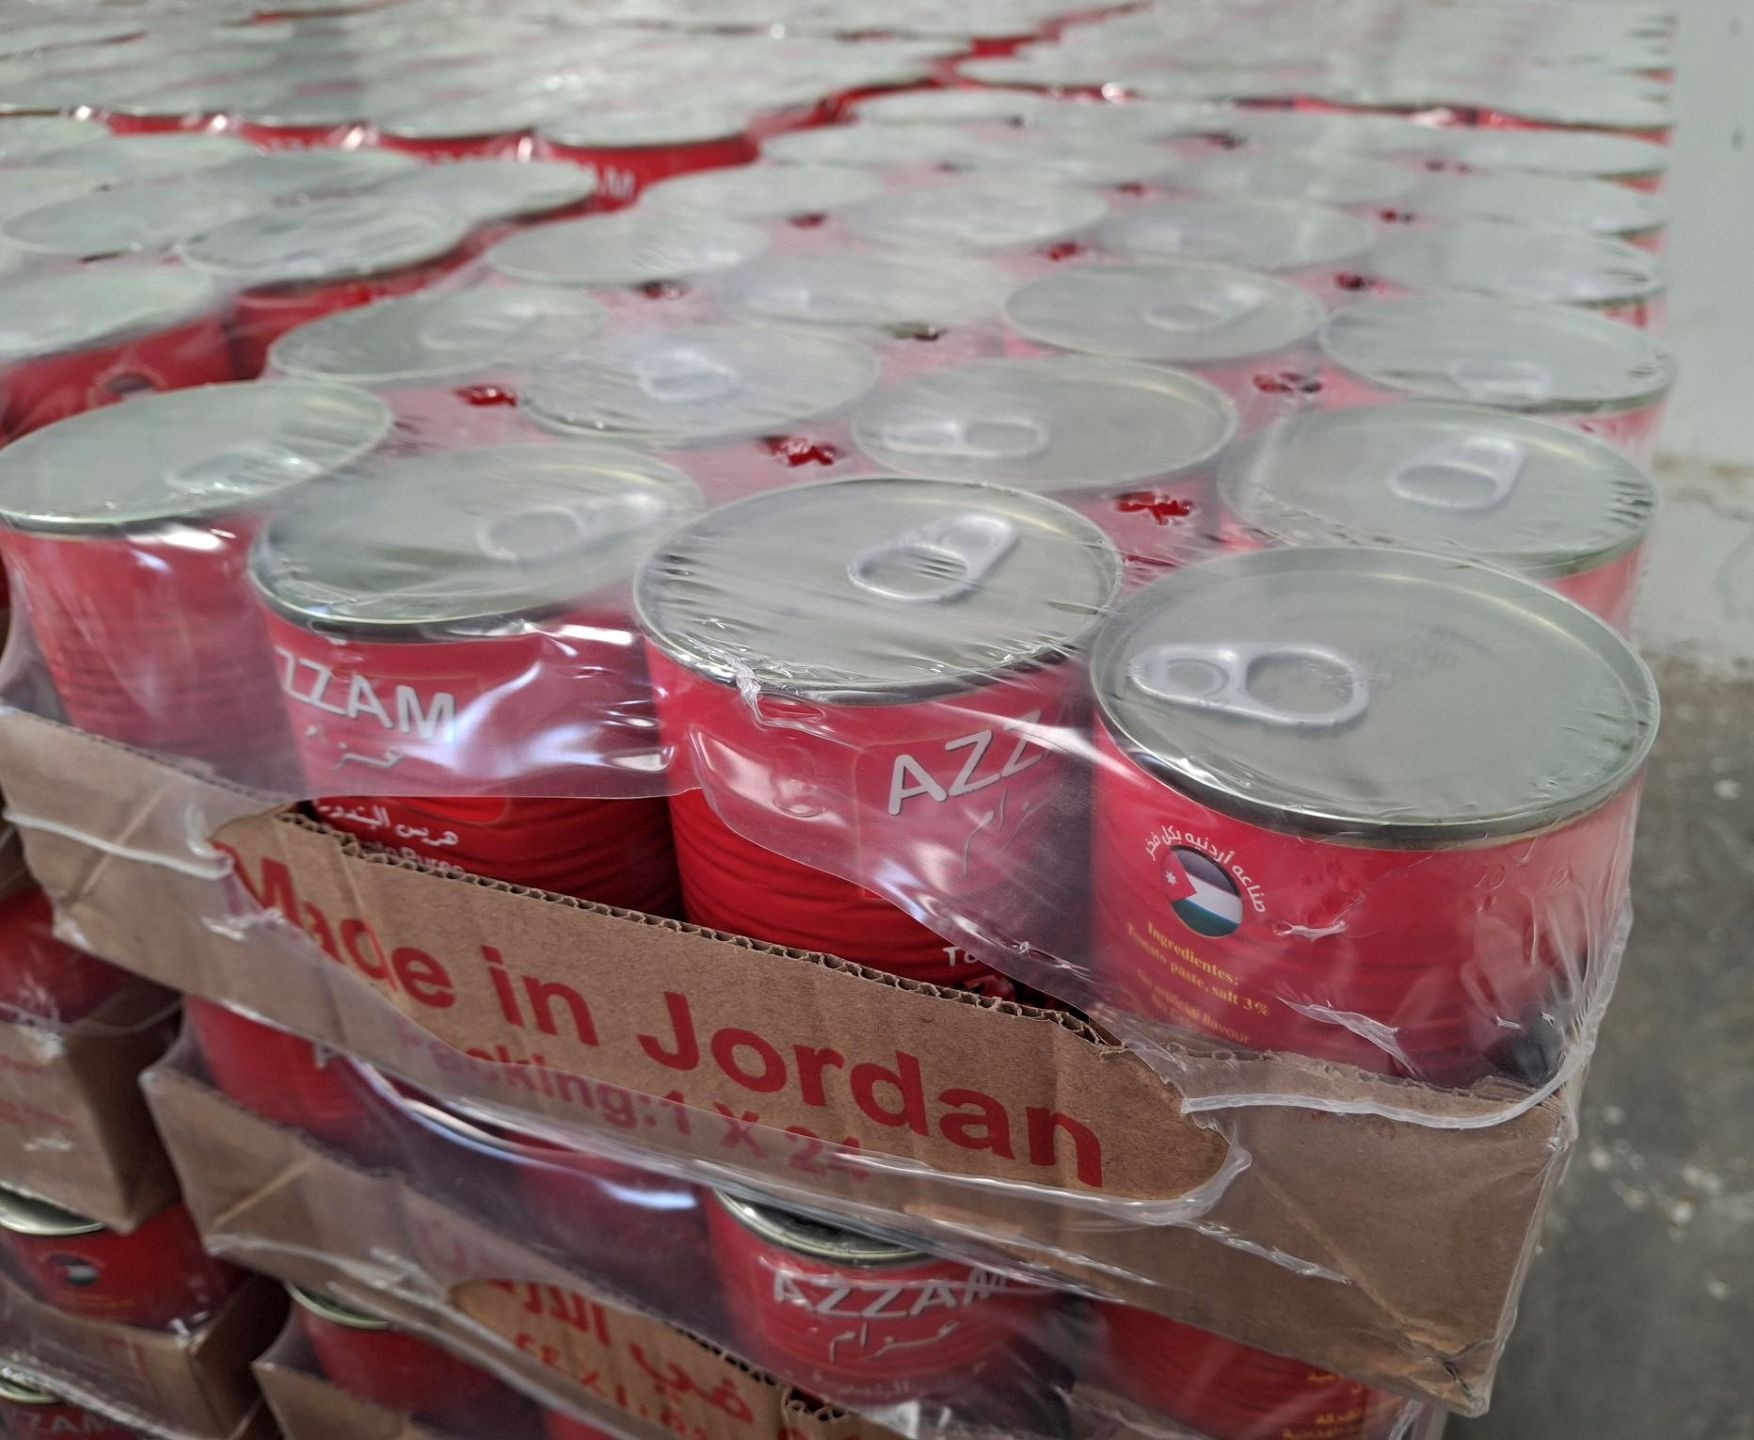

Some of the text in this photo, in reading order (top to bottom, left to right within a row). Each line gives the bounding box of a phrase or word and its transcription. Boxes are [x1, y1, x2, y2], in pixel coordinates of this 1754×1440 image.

[888, 709, 1050, 816] AZZ
[1144, 830, 1162, 862] فخر
[1161, 824, 1183, 846] بكل
[1211, 985, 1240, 1006] salt
[1242, 997, 1271, 1017] 3%
[480, 944, 600, 1047] in
[636, 990, 1104, 1189] Jordan
